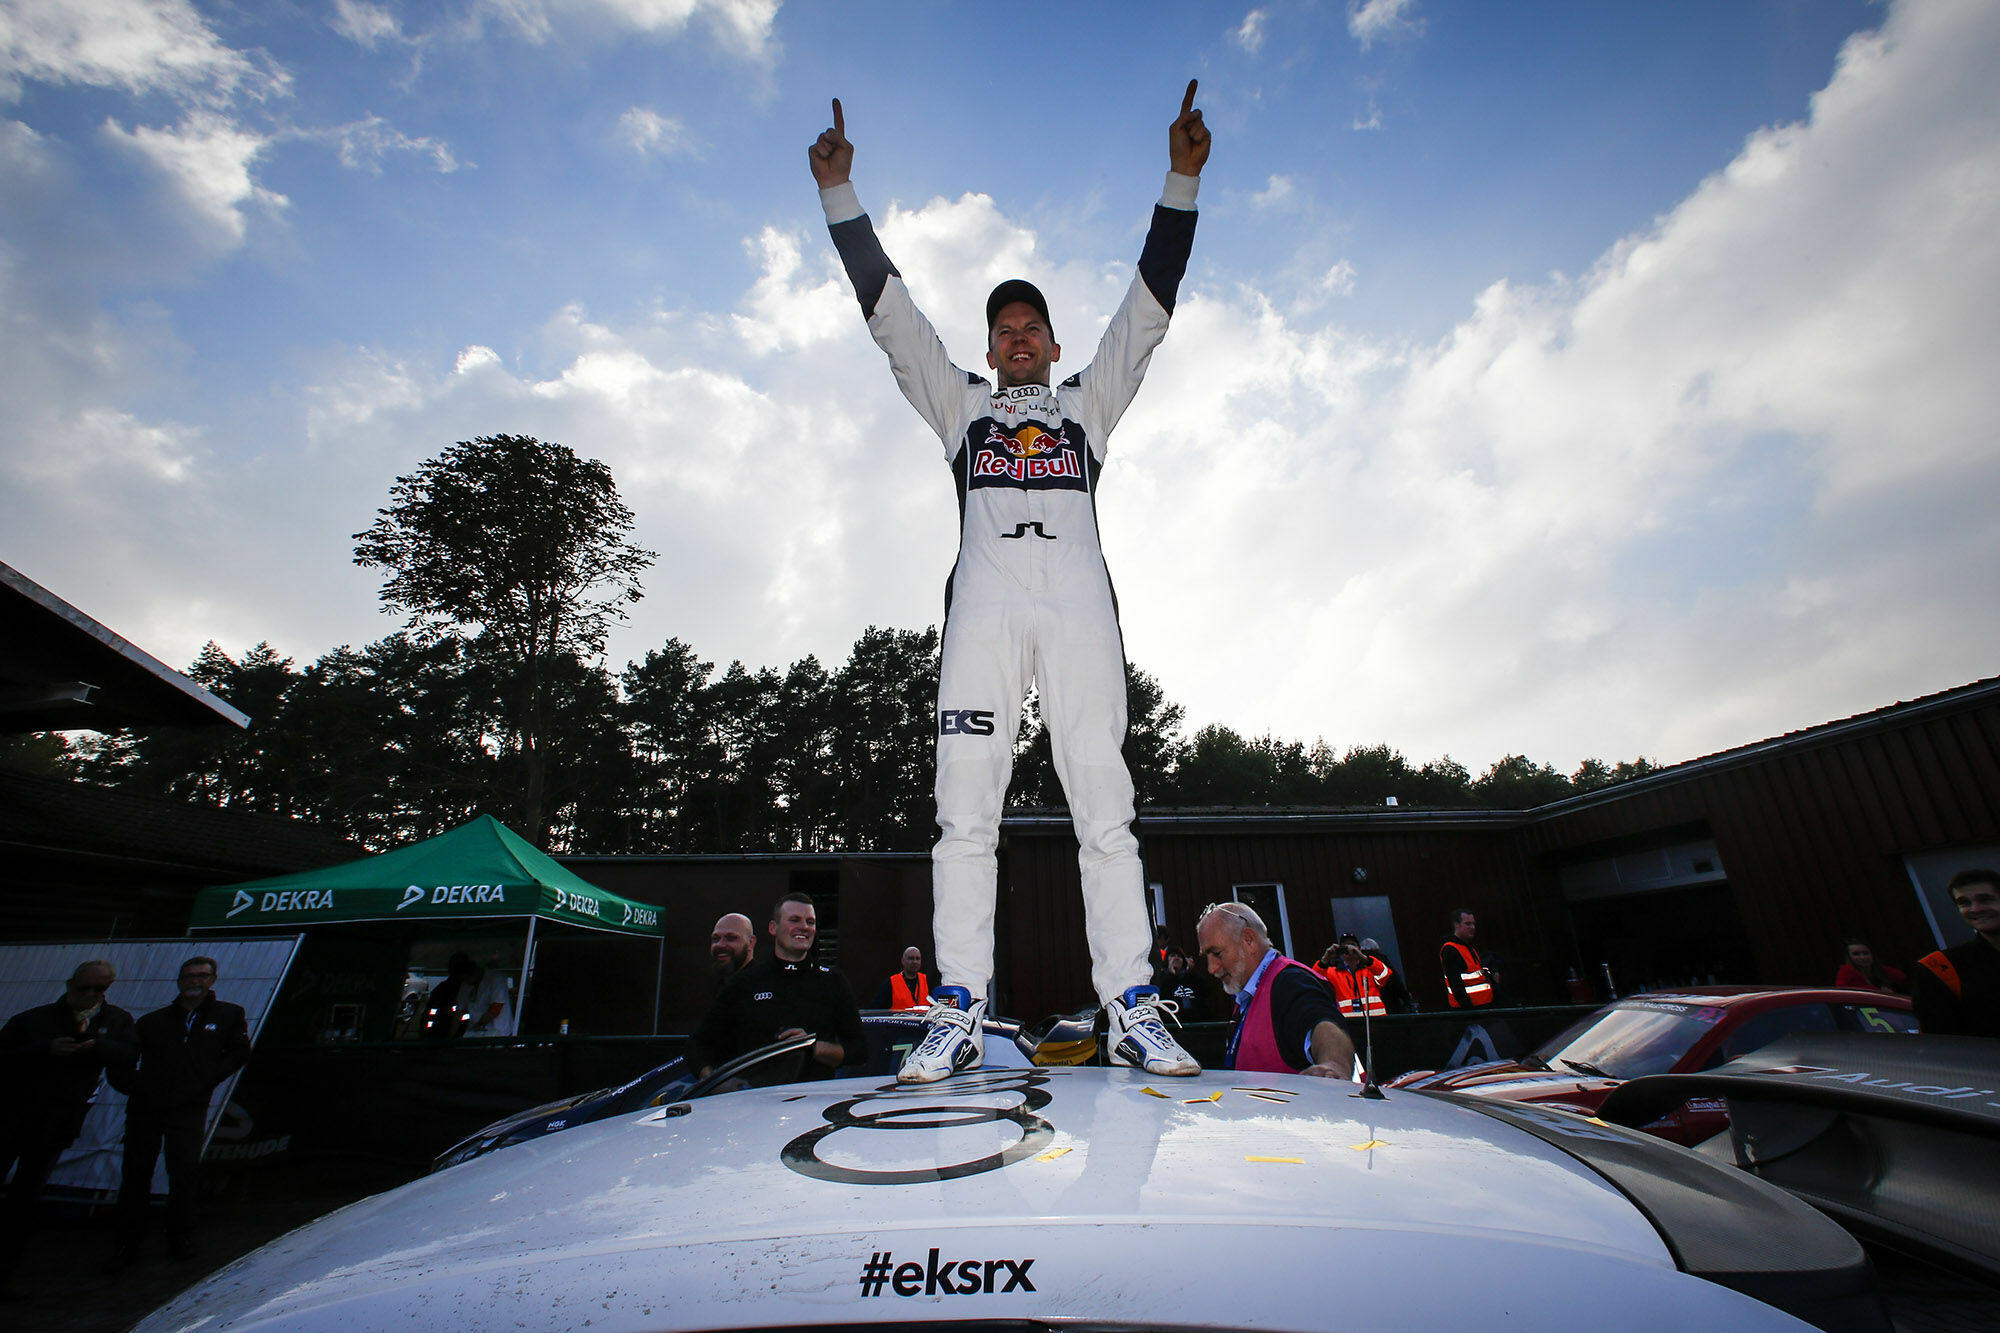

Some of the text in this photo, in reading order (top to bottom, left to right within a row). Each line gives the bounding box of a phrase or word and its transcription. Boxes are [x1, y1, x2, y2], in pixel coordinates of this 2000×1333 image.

[974, 449, 1081, 481] Red Bull
[941, 710, 995, 736] EKS
[260, 889, 334, 912] DEKRA
[431, 884, 505, 904] DEKRA
[569, 893, 600, 917] DEKRA
[633, 908, 657, 926] DEKRA
[1859, 1007, 1896, 1033] 5
[892, 1043, 914, 1068] 7
[1812, 1072, 1995, 1099] Audi
[859, 1247, 1037, 1297] #eksrx
